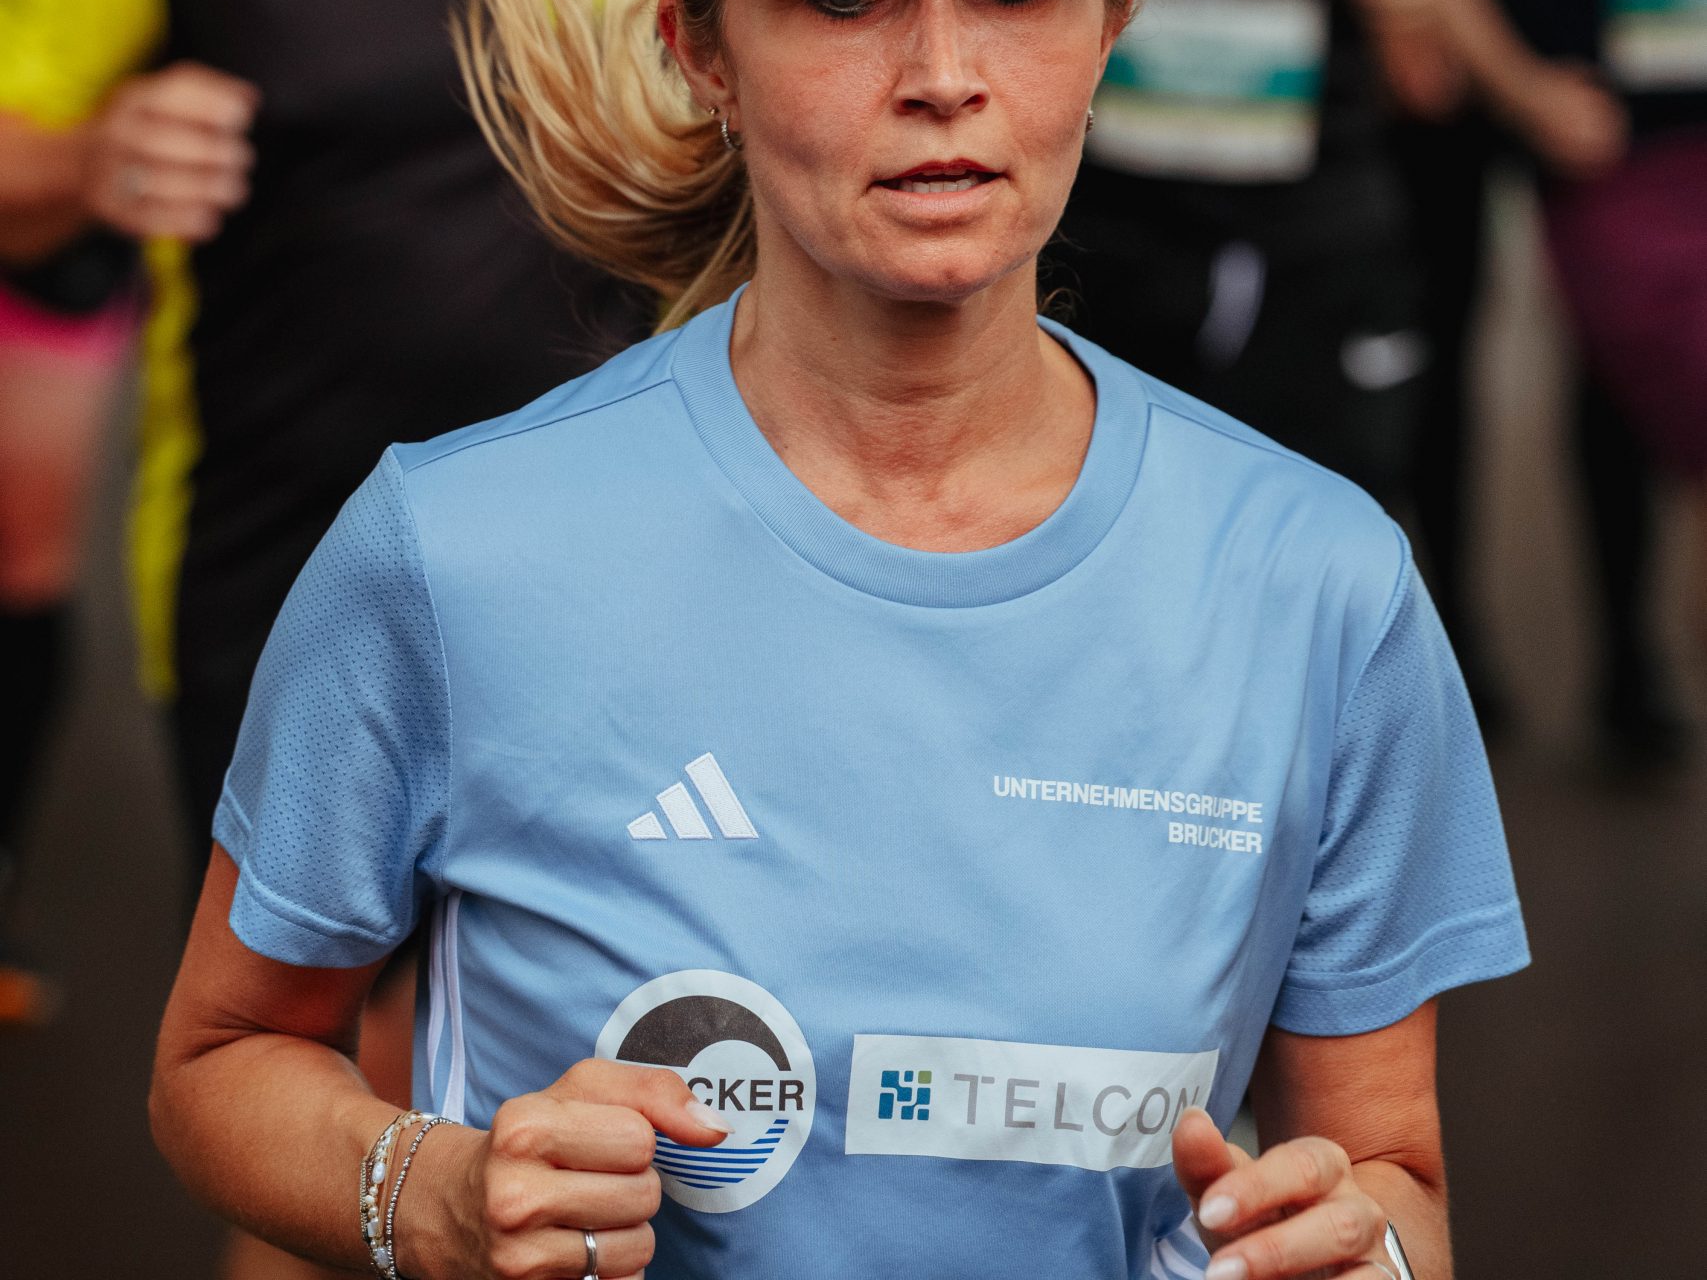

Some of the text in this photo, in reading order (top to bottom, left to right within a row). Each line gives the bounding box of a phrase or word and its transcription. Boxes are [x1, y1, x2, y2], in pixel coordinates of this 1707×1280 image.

[993, 775, 1264, 824] UNTERNEHMENSGRUPPE
[1168, 821, 1263, 854] BRUCKER
[687, 1076, 805, 1112] CKER
